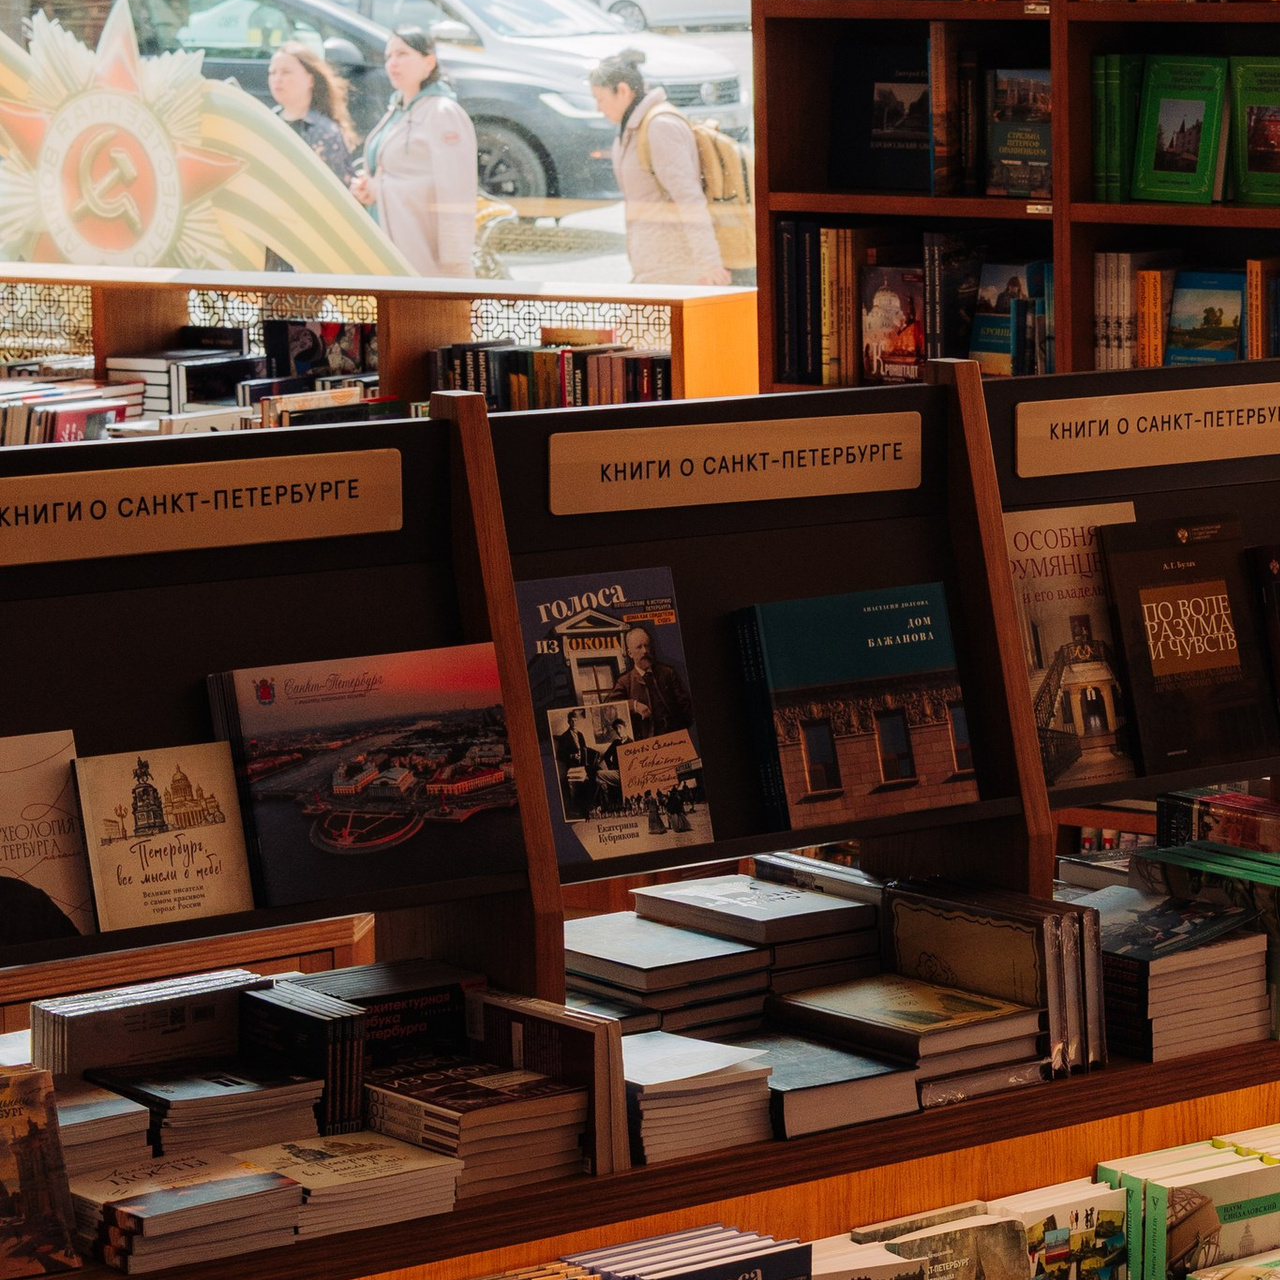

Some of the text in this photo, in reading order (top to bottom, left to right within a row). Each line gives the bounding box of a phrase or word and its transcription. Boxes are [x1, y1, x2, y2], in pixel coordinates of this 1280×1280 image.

[1049, 418, 1110, 441] КНИГИ
[1116, 417, 1130, 436] О
[600, 441, 904, 483] КНИГИ О САНКТ-ПЕТЕРБУРГЕ
[89, 499, 107, 520] О
[117, 477, 360, 519] САНКТ-ПЕТЕРБУРГЕ
[1034, 589, 1054, 603] его
[1142, 594, 1231, 622] ПО ВОЛЕ
[907, 616, 931, 629] ДОМ
[1145, 614, 1235, 643] РАЗУМА
[867, 631, 934, 648] БАЖАНОВА
[1150, 632, 1238, 660] И ЧУВСТВ
[597, 822, 639, 834] Екатерина
[598, 832, 639, 845] Кубрякова
[130, 833, 207, 871] Петербург,
[117, 865, 133, 886] все
[141, 872, 177, 885] мысли
[1223, 1202, 1243, 1213] НАУМ
[1223, 1202, 1277, 1222] СИНДАЛОВСКИЙ
